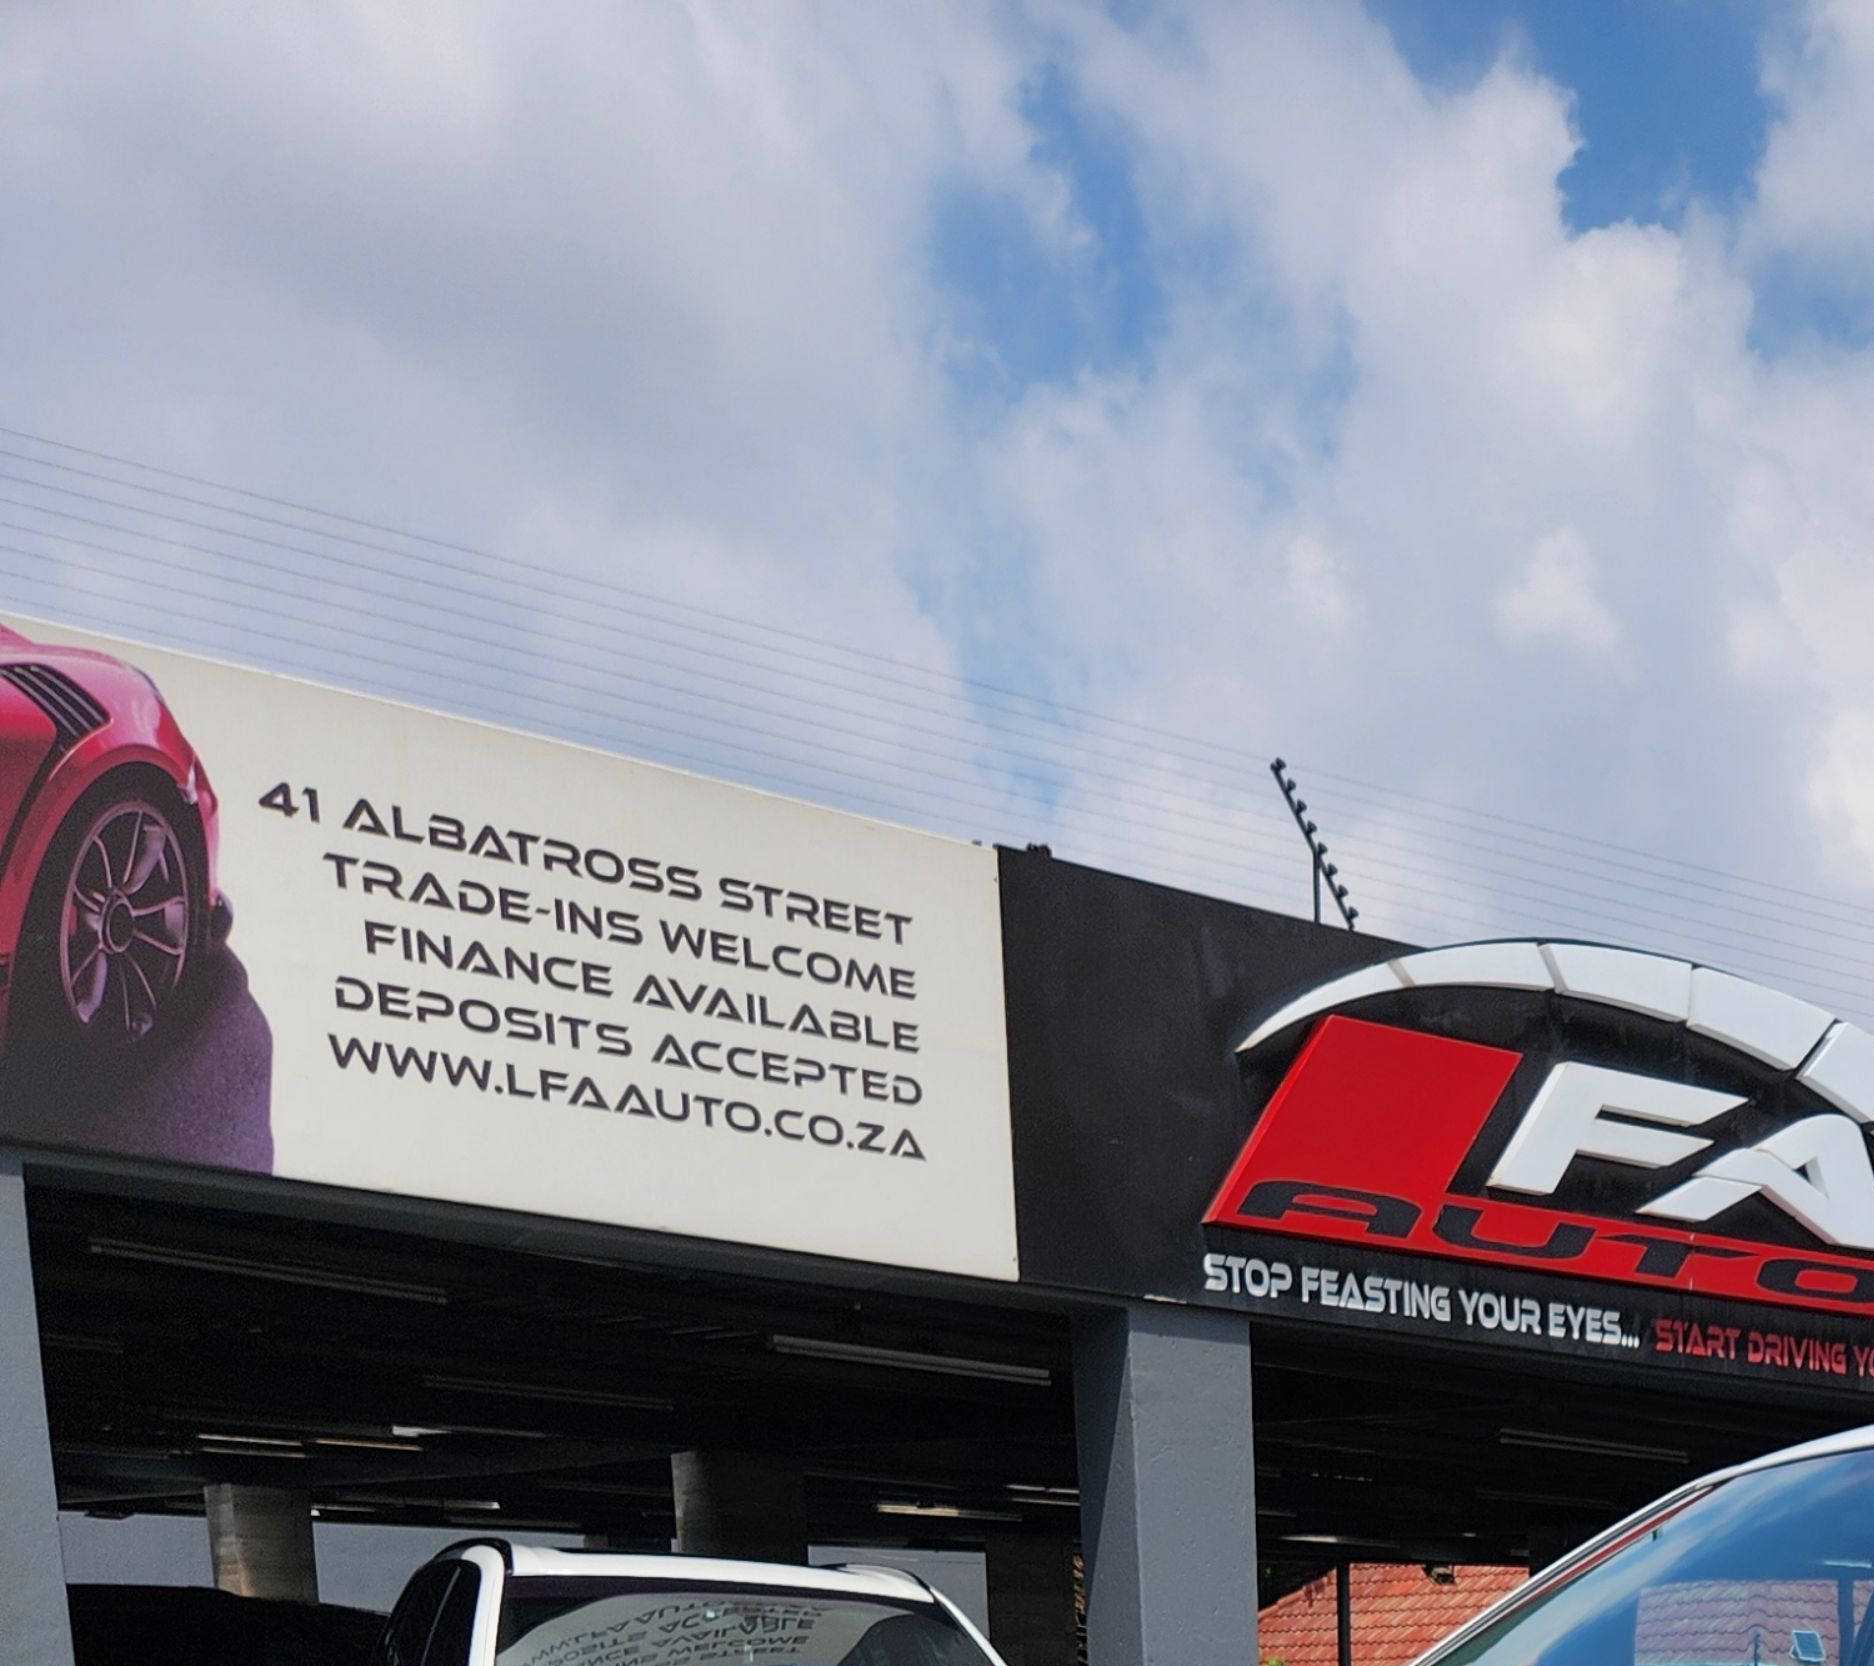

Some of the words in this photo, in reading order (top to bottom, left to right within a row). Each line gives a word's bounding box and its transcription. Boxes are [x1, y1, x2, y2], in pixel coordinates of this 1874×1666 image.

[258, 781, 321, 823] 41
[342, 797, 703, 902] ALBATROSS
[717, 876, 914, 945] STREET
[322, 851, 644, 947] TRADE-INS
[658, 918, 918, 1000] WELCOME
[335, 976, 633, 1058] DEPOSITS
[651, 1033, 923, 1107] ACCEPTED
[363, 920, 614, 998] FINANCE
[633, 973, 921, 1055] AVAILABLE
[327, 1033, 927, 1161] WWW.LFAAUTO.CO.ZA
[1202, 1253, 1293, 1299] STOP
[1301, 1267, 1452, 1322] FEASTING
[1457, 1289, 1542, 1335] YOUR
[1547, 1302, 1641, 1348] EYES...
[1655, 1317, 1741, 1360] START
[1747, 1331, 1847, 1376] DRIVING
